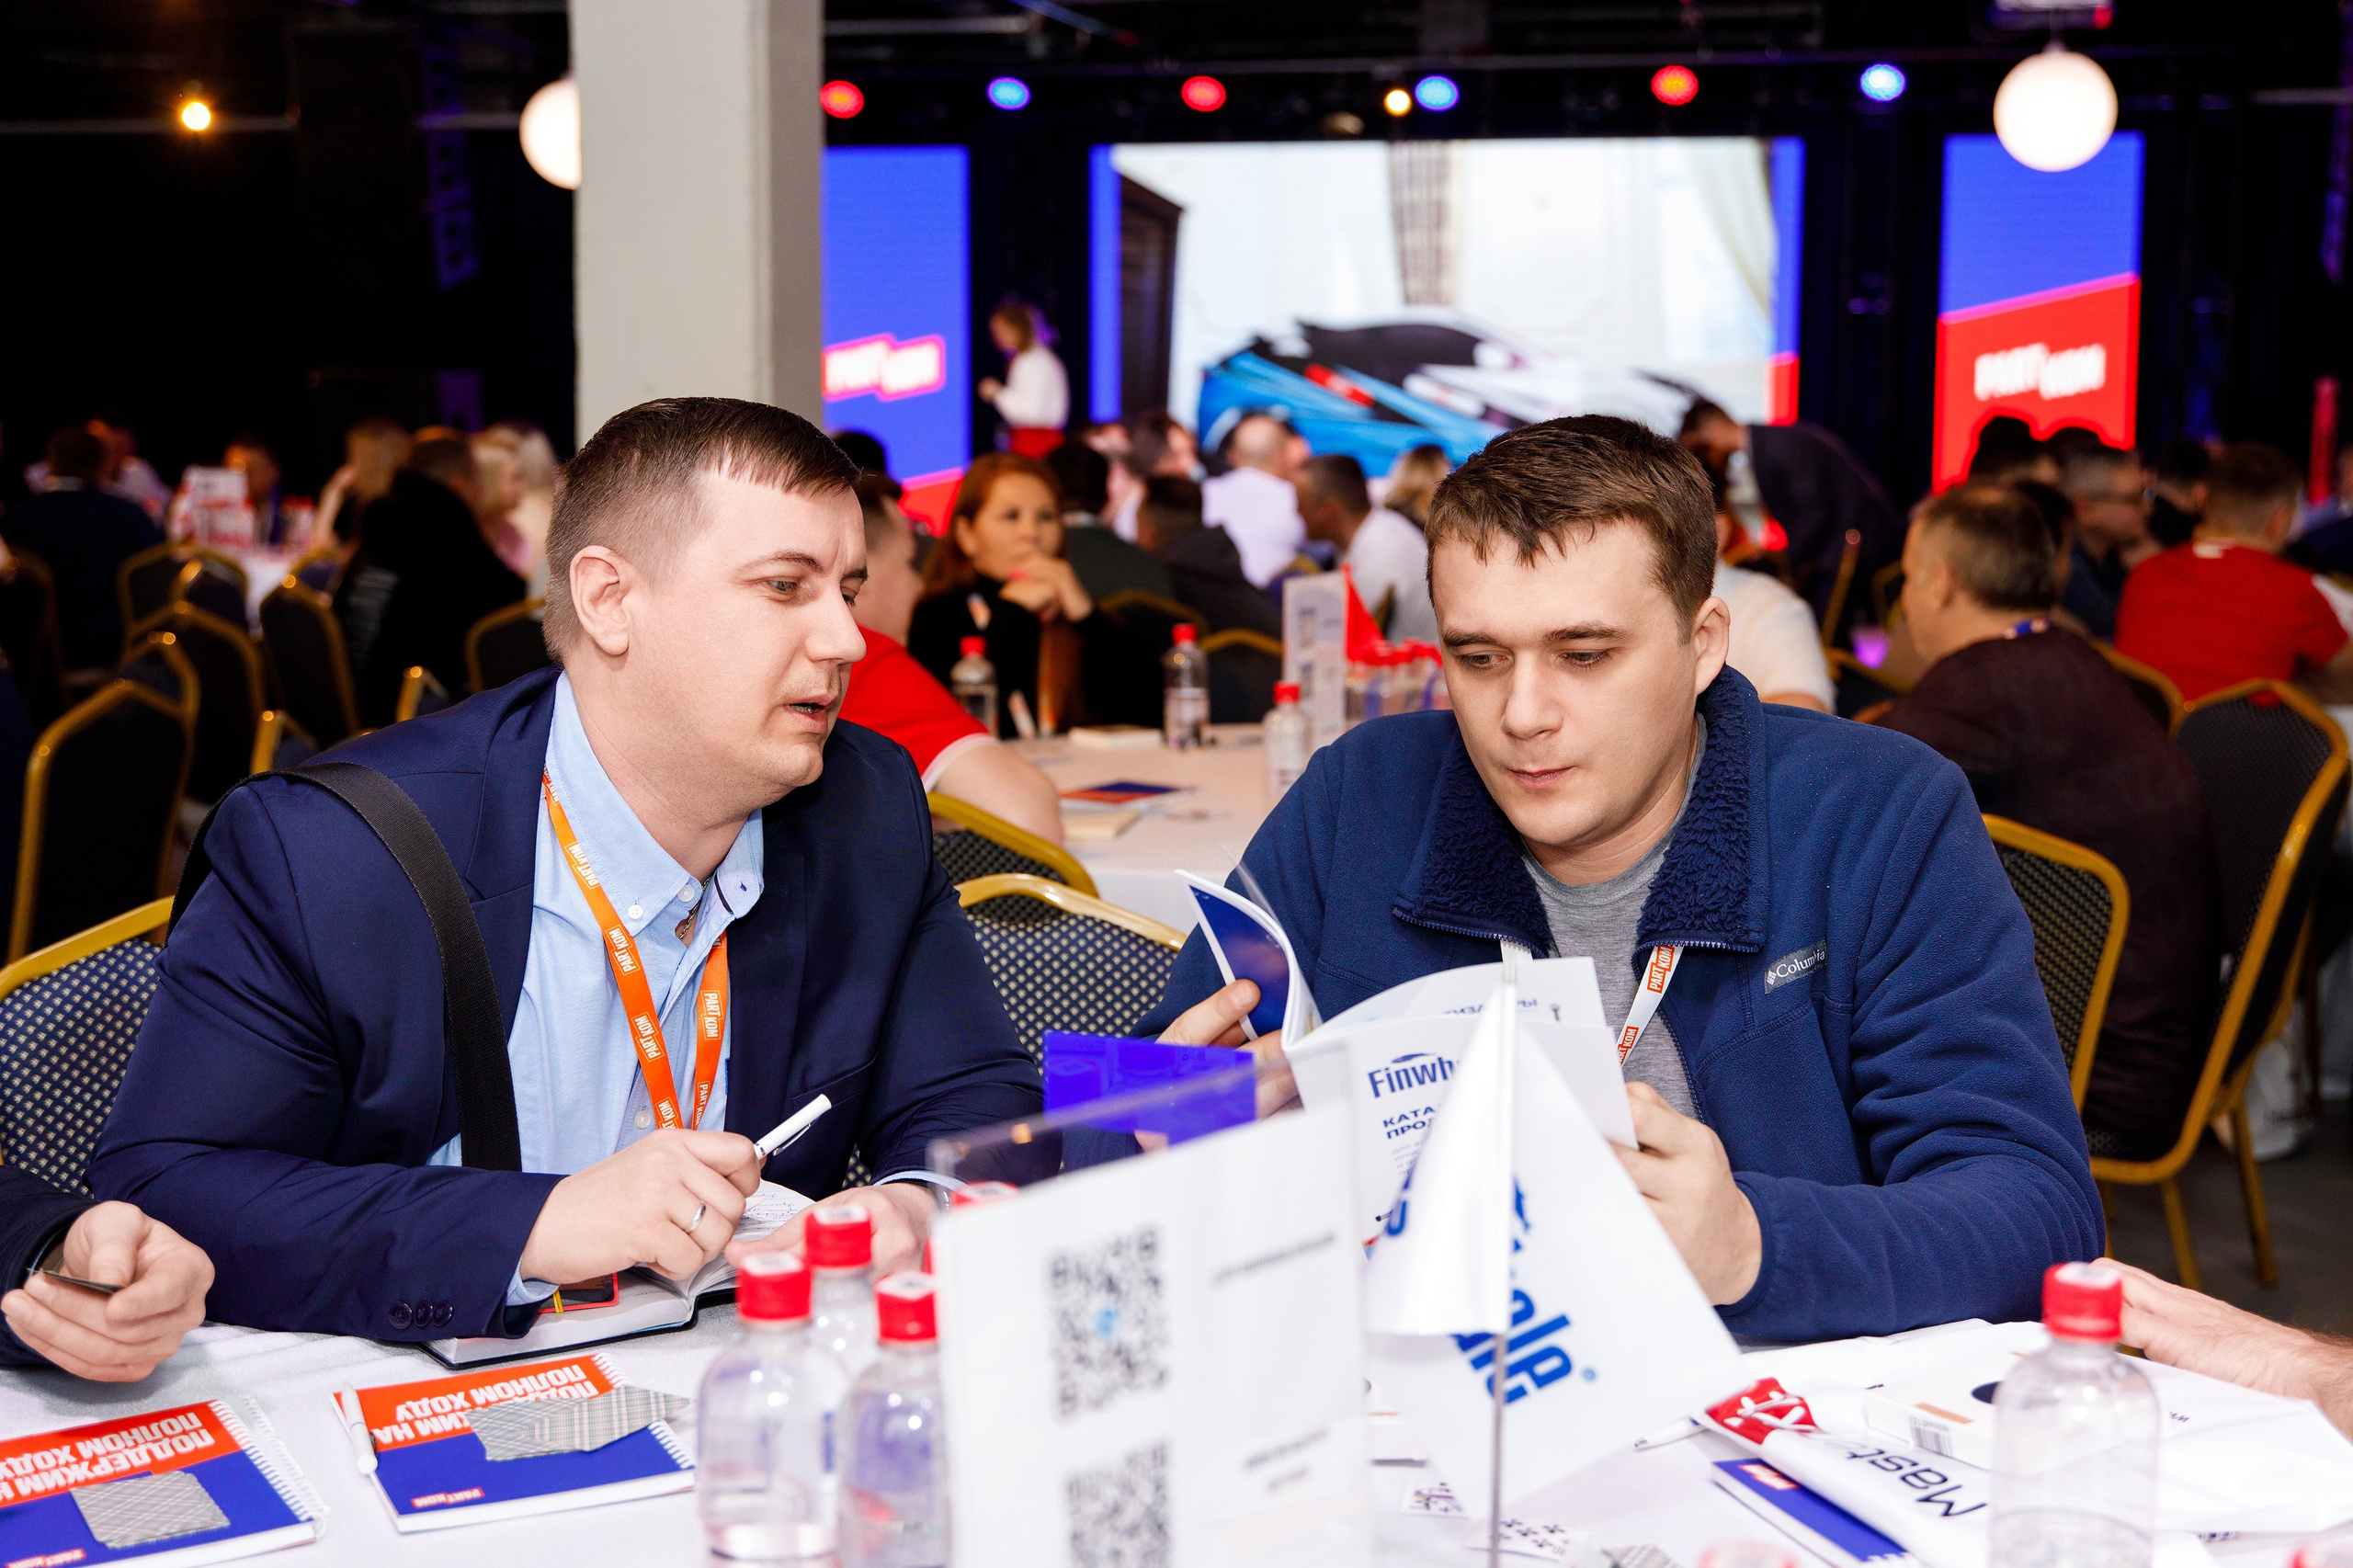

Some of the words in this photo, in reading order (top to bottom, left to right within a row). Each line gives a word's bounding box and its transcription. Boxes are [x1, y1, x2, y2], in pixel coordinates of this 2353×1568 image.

[608, 927, 630, 951] KOM
[615, 948, 637, 973] PART
[1649, 965, 1665, 991] PART
[1658, 946, 1673, 970] KOM
[704, 992, 722, 1018] PART
[634, 1015, 657, 1038] KOM
[704, 1016, 719, 1039] KOM
[1623, 1028, 1637, 1048] KOM
[639, 1034, 662, 1060] PART
[1368, 1057, 1458, 1098] Finwh
[699, 1083, 709, 1106] PART
[658, 1100, 676, 1121] KOM
[1382, 1106, 1437, 1128] КАТА
[470, 1364, 587, 1406] ПОЛНОМ
[395, 1391, 472, 1423] ХОДУ
[76, 1412, 203, 1460] ПОЛНОМ
[373, 1421, 415, 1445] НА
[16, 1428, 216, 1494] ПОДДЕРЖИМ
[1836, 1442, 1987, 1517] Mast
